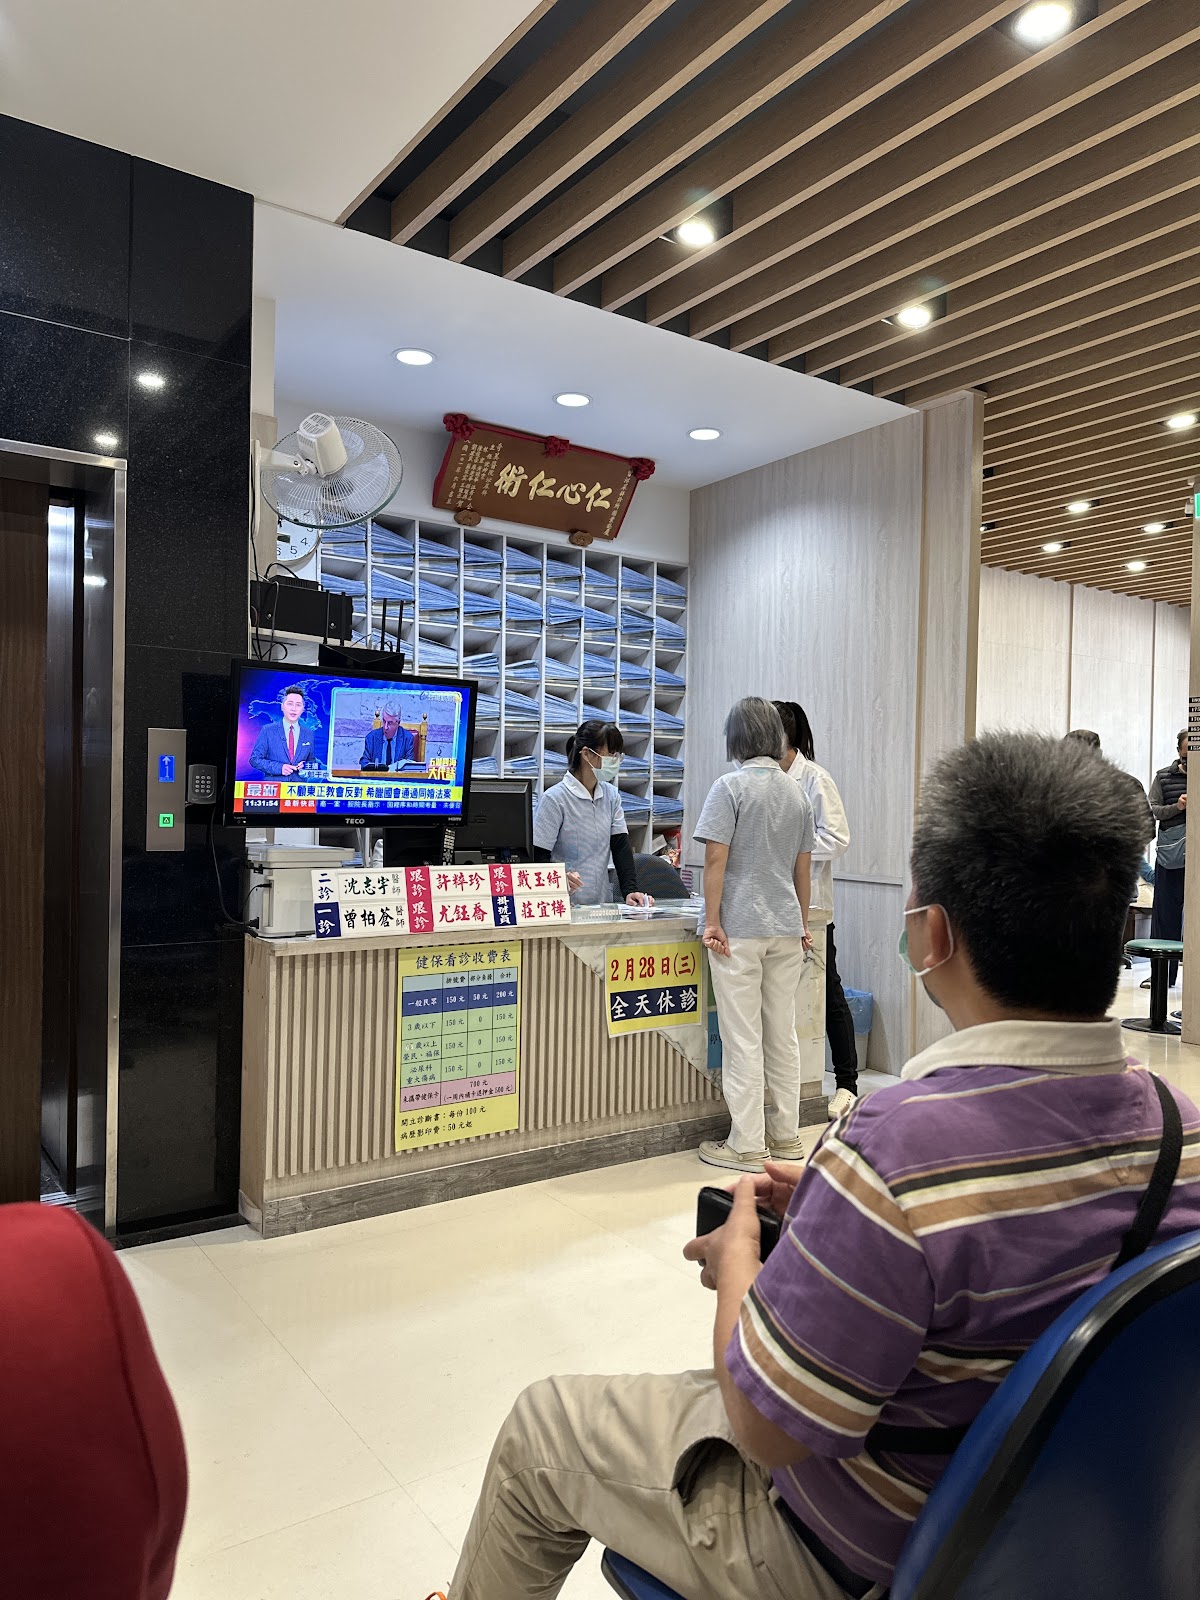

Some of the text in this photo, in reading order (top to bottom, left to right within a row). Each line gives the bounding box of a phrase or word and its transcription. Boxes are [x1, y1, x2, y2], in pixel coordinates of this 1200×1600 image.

[290, 545, 298, 555] 5
[300, 537, 309, 546] 4
[247, 783, 278, 796] 最新
[287, 785, 451, 799] 不顧東正教會反對 希臘國會通過同婚法案
[318, 872, 334, 901] 二診
[410, 869, 427, 898] 跟診
[493, 866, 509, 893] 跟診
[317, 908, 335, 935] 一診
[344, 905, 405, 929] 曾柏蒼 醫師
[412, 901, 429, 930] 跟診
[439, 901, 488, 924] 尤鈺喬
[497, 896, 512, 925] 掛號員
[416, 949, 511, 969] 健保看診收費表
[408, 997, 437, 1007] 一般民眾
[611, 987, 698, 1019] 全天休診
[410, 1064, 432, 1073] 泌尿科
